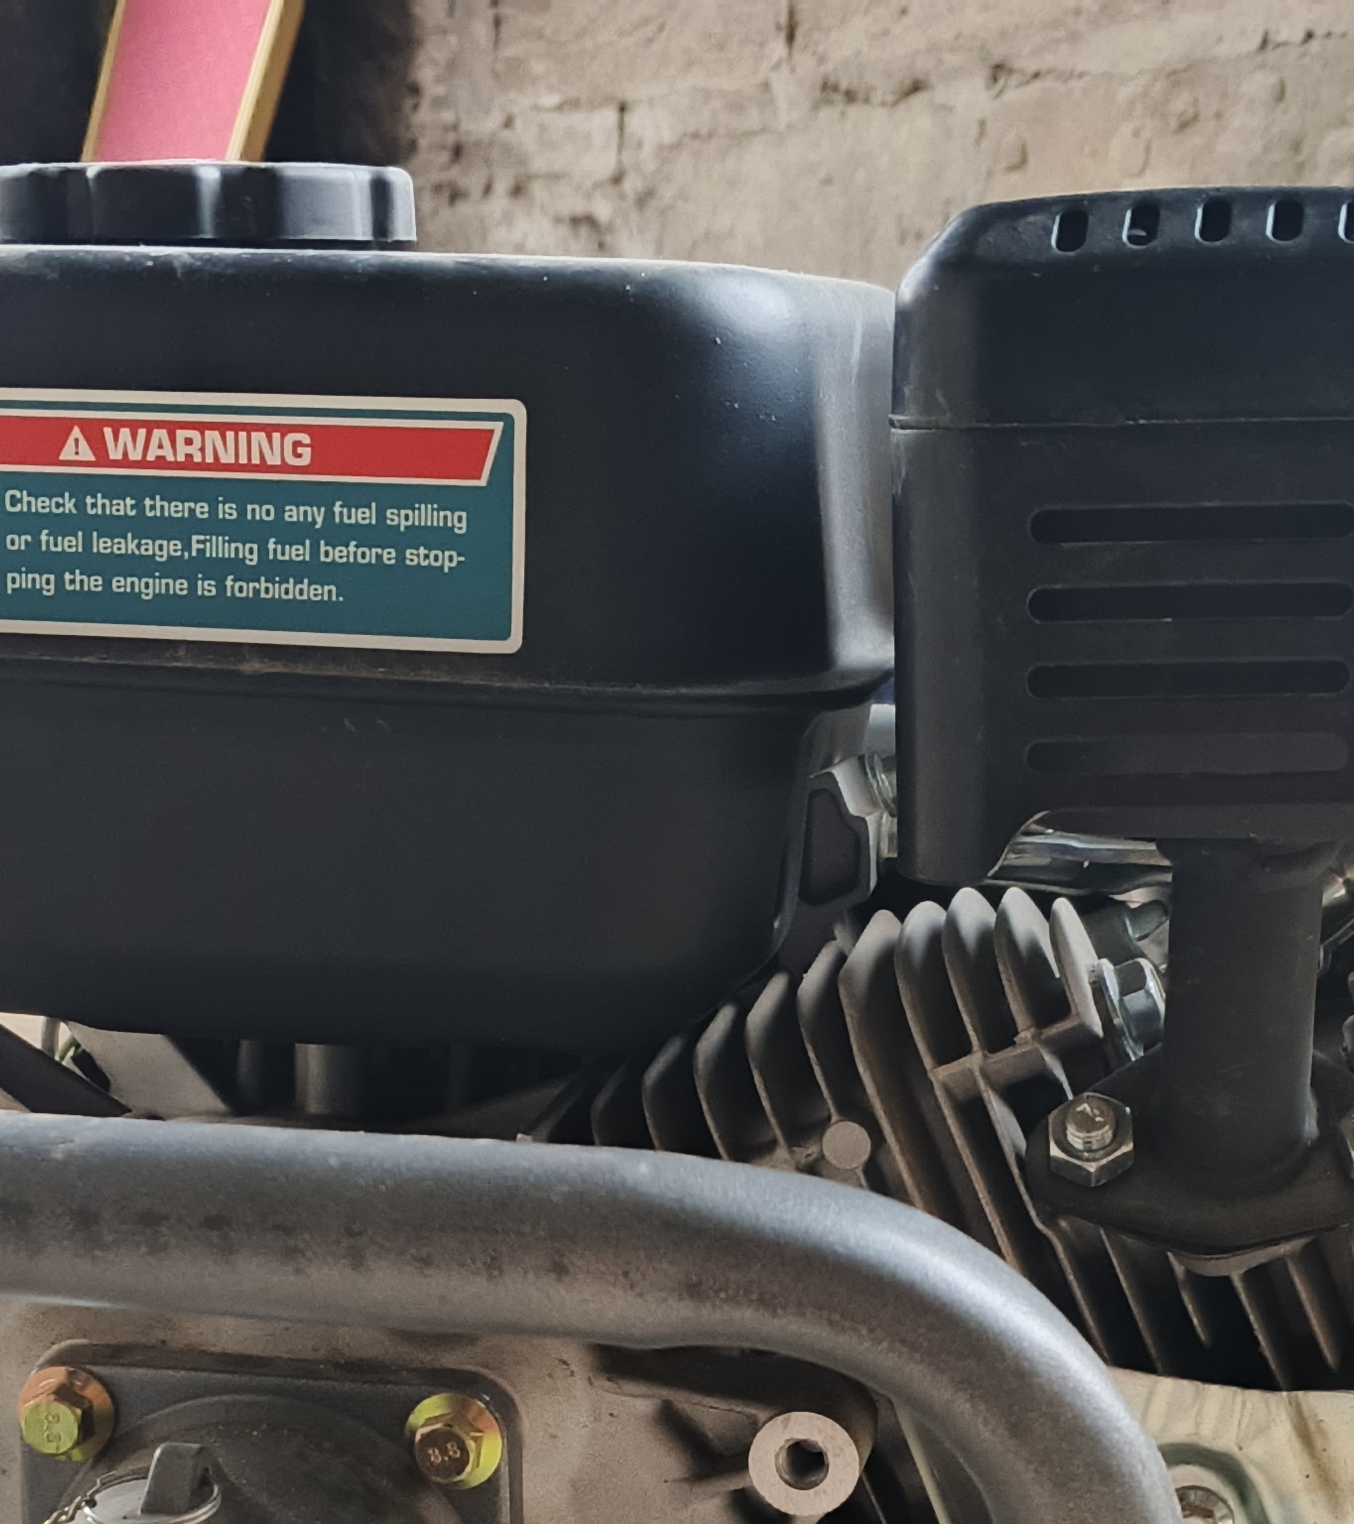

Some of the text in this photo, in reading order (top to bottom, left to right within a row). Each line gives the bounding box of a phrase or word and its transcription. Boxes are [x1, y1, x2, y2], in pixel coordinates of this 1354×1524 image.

[103, 426, 312, 466] WARNING
[4, 489, 467, 535] Check that there is no any fuel spilling
[5, 534, 32, 551] or
[39, 529, 83, 553] fuel
[267, 537, 311, 562] fuel
[319, 539, 397, 565] before
[405, 545, 466, 573] stop-
[6, 566, 344, 602] ping the engine is forbidden.
